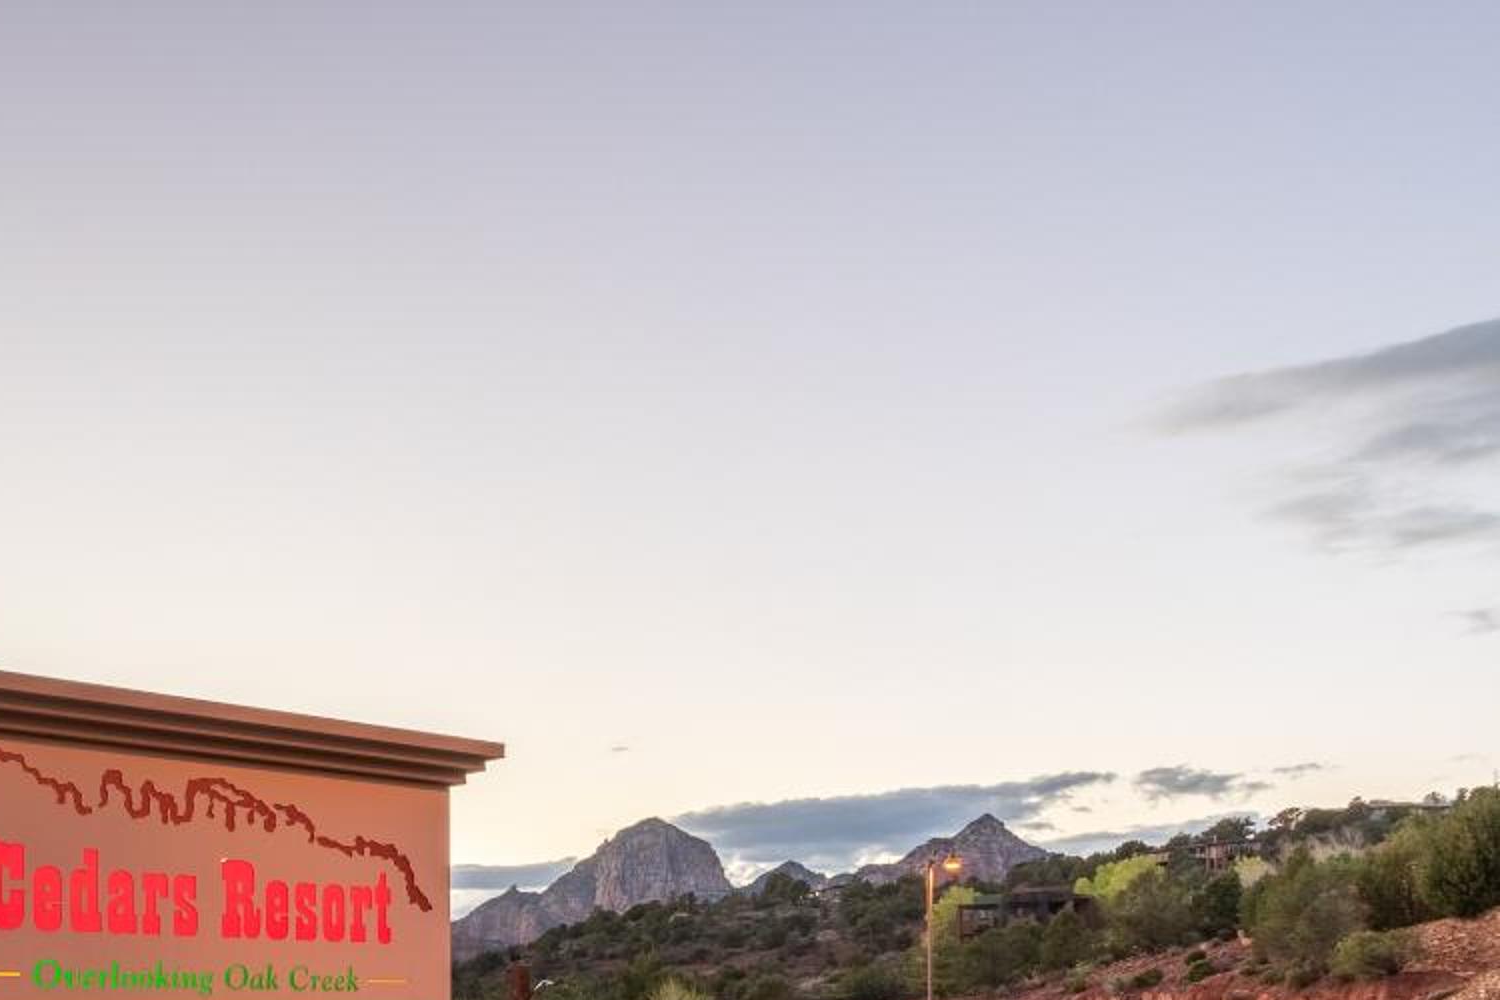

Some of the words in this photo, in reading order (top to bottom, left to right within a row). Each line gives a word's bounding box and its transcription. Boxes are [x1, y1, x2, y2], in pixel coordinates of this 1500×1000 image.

[221, 859, 392, 945] Resort
[31, 958, 213, 994] Overlooking
[224, 962, 279, 991] Oak
[288, 964, 359, 992] Creek
